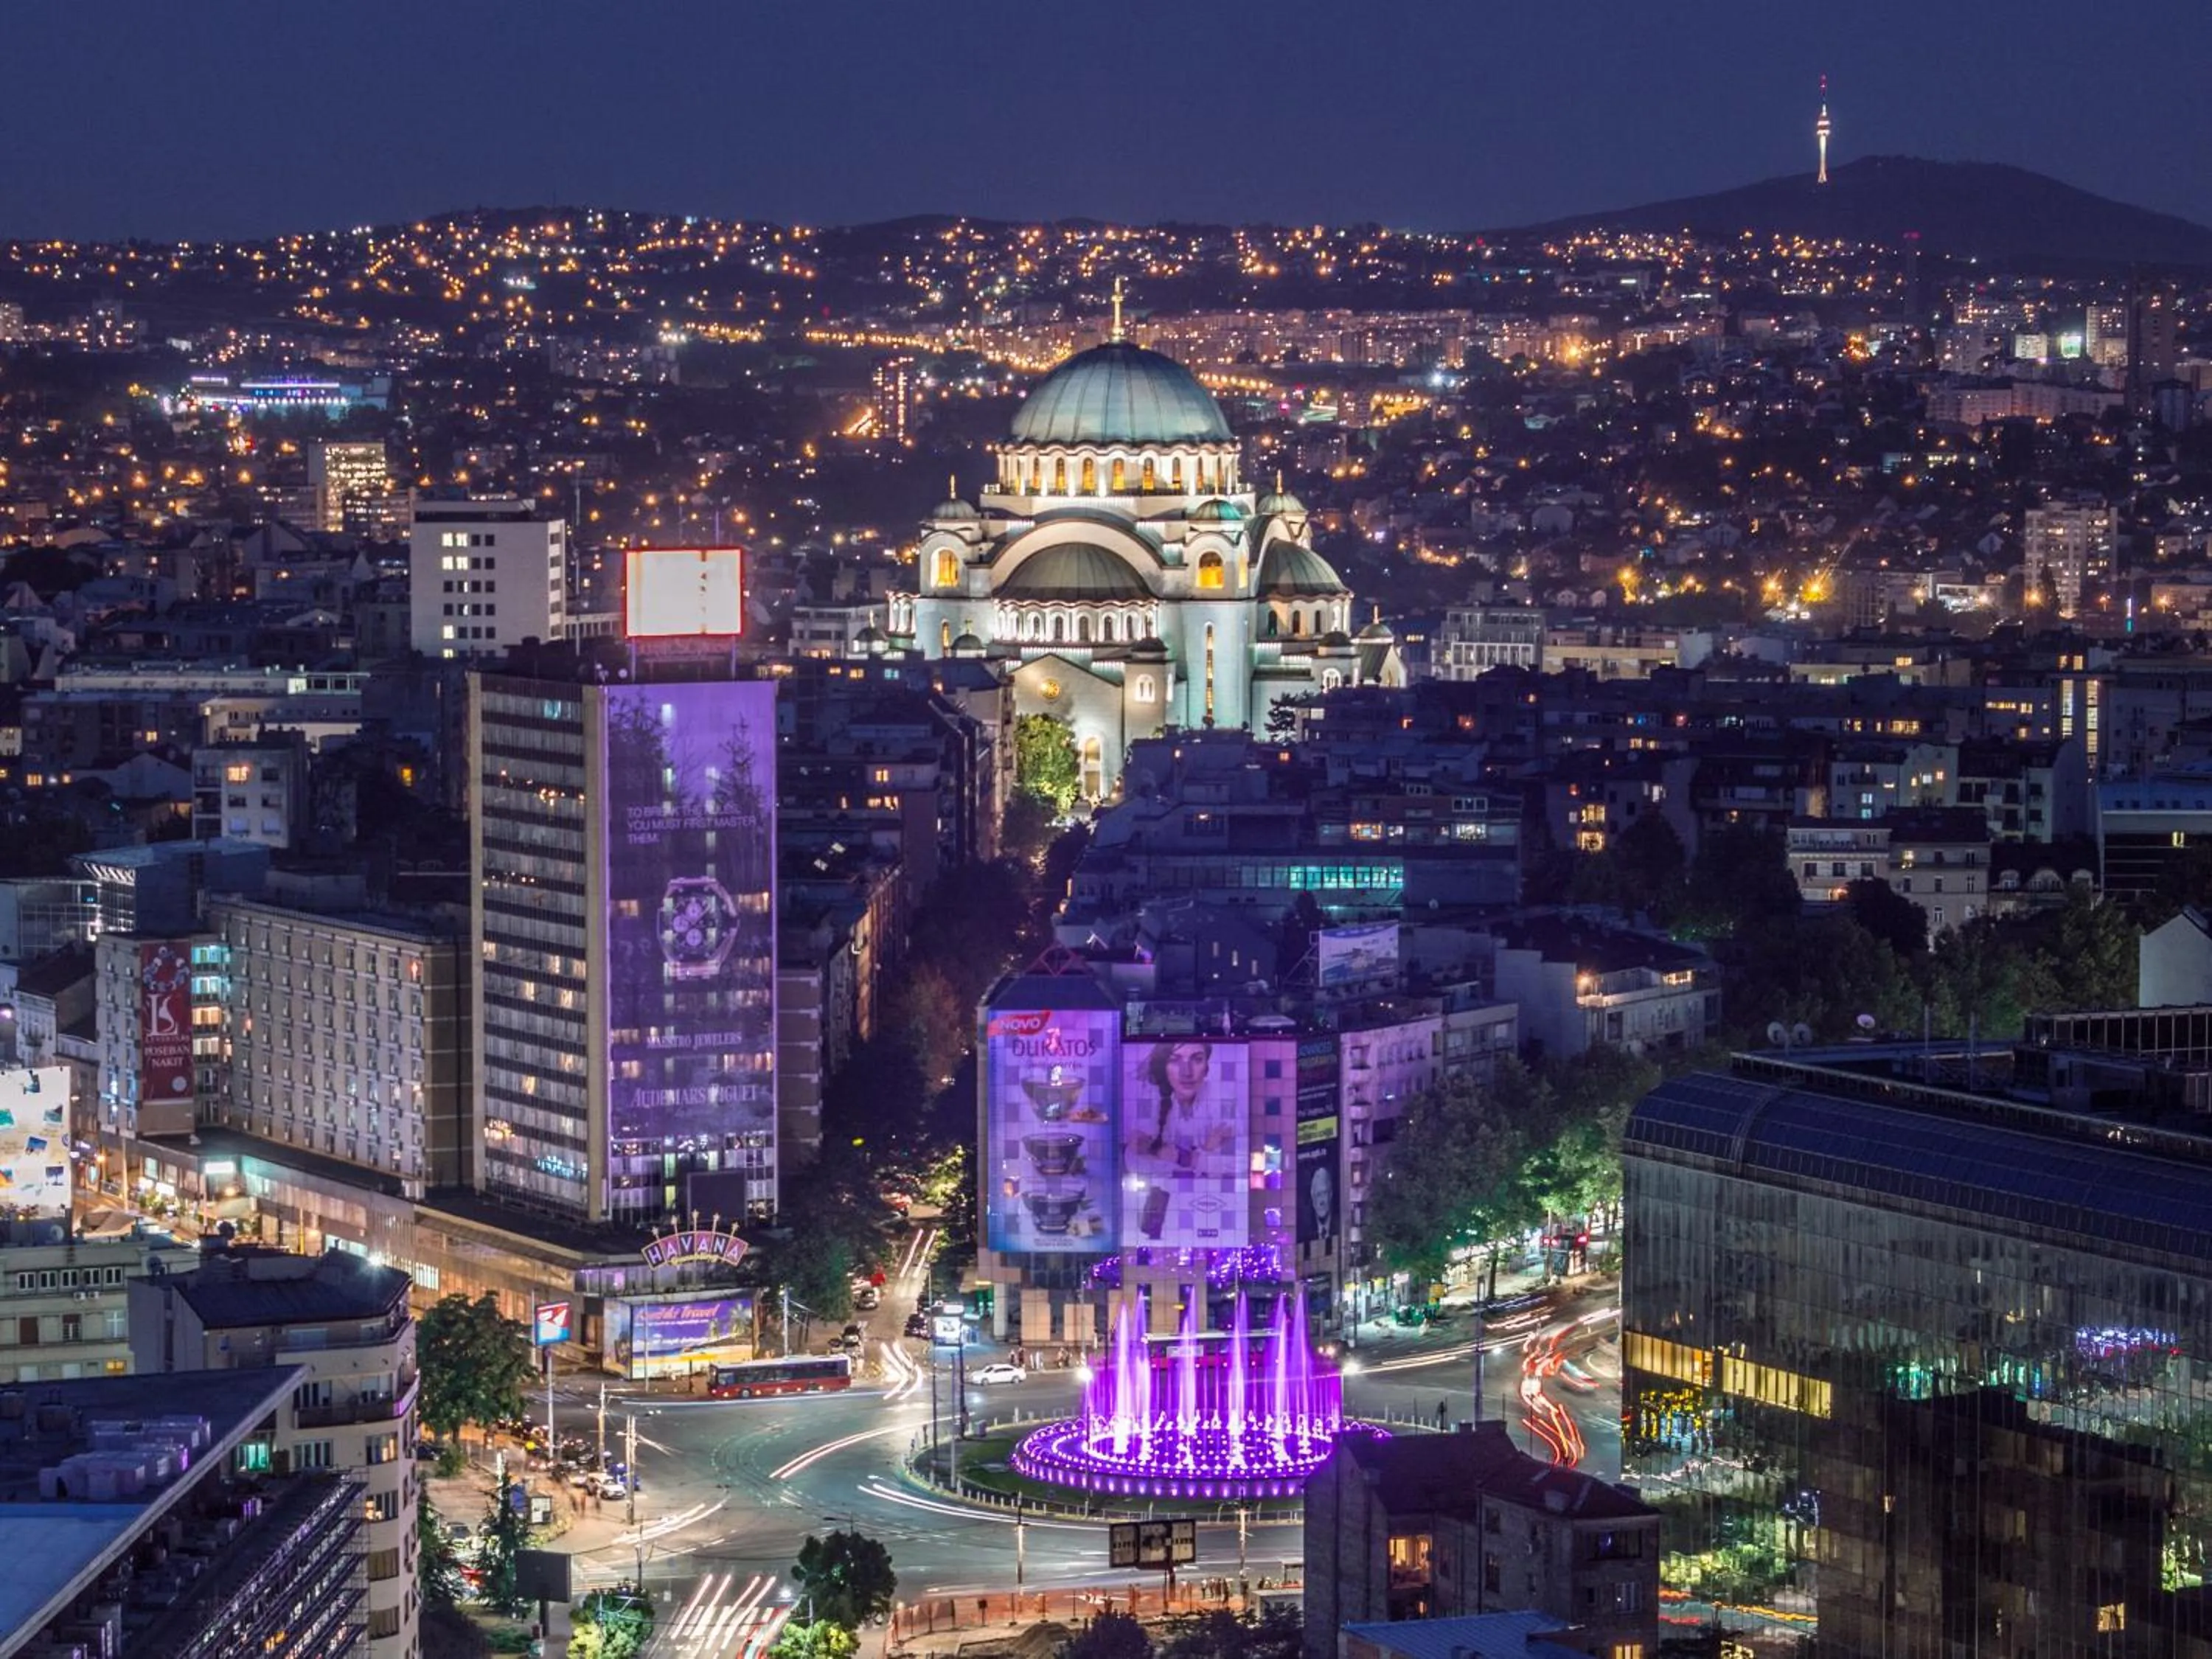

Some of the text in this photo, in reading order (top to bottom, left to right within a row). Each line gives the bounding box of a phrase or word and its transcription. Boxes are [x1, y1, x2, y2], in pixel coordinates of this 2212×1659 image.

[627, 818, 650, 831] YOU
[652, 817, 681, 830] MUST
[714, 815, 757, 827] MASTER
[1000, 1017, 1041, 1031] NOVO
[647, 1032, 742, 1051] MAESTRO JEWELERS
[1012, 1039, 1096, 1057] DUKATOS
[647, 1235, 739, 1265] HAVANA
